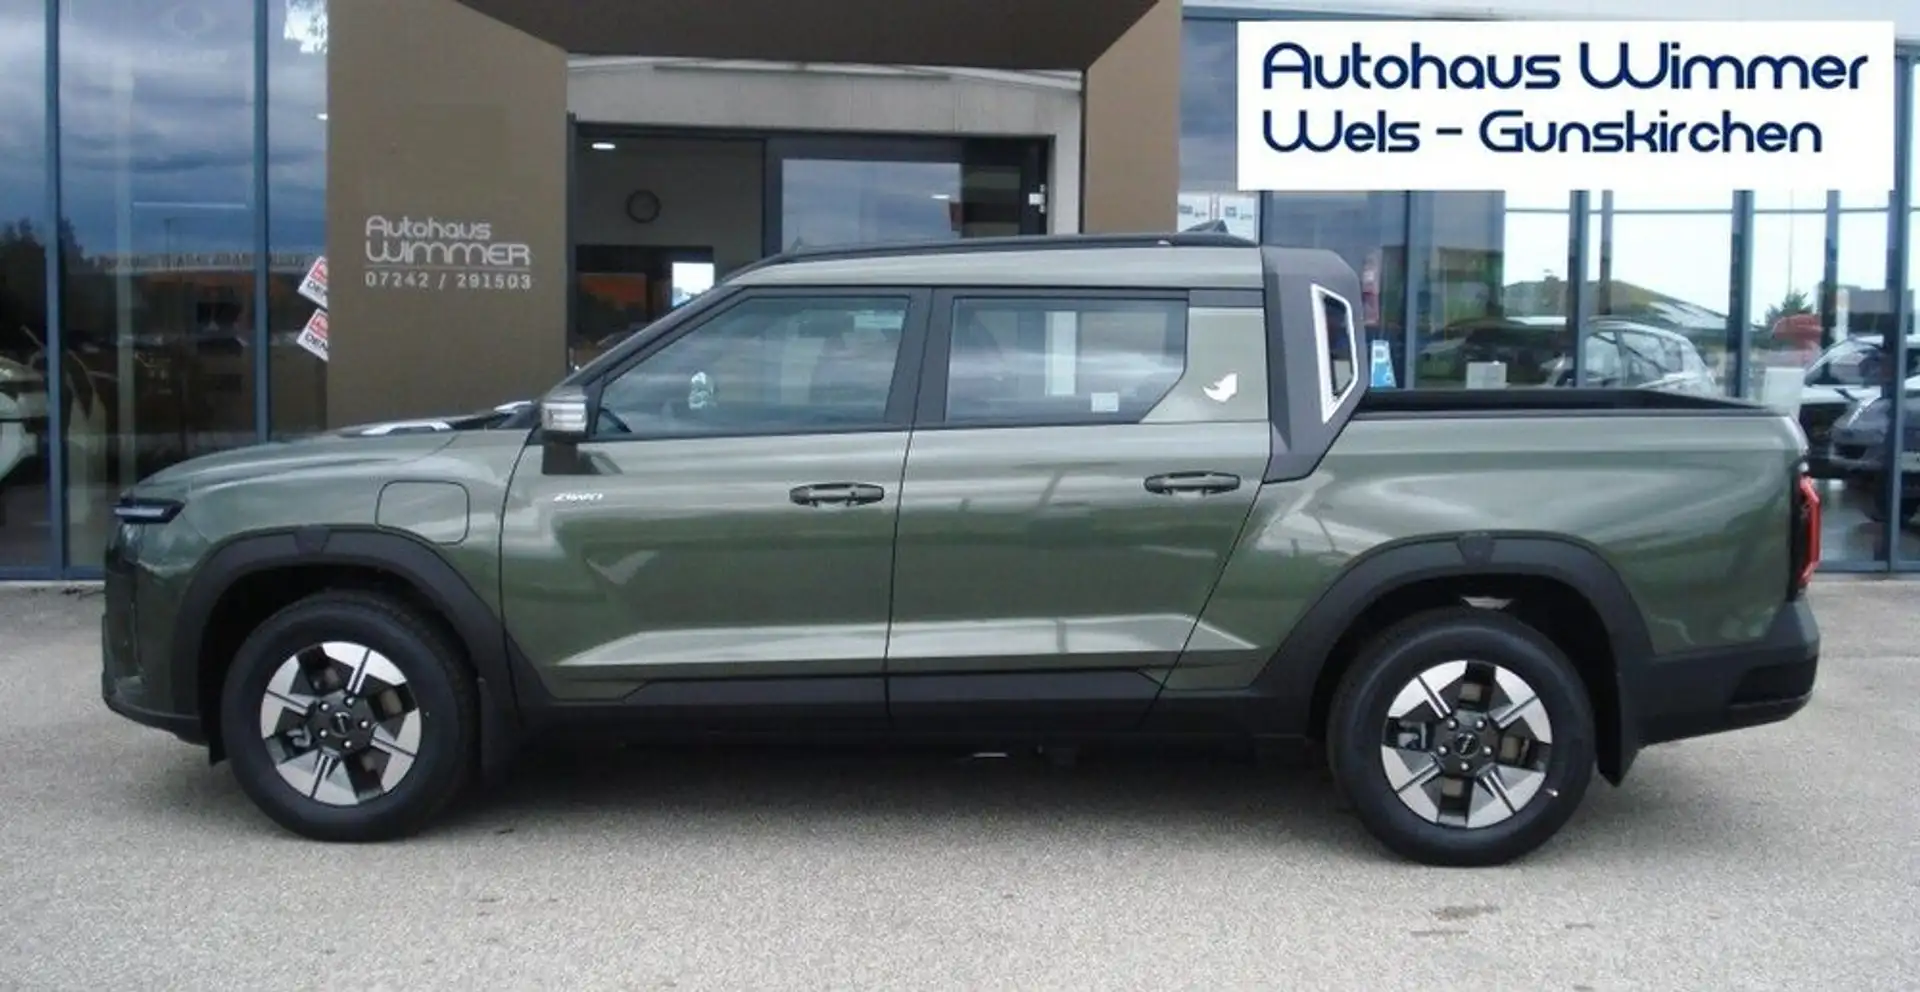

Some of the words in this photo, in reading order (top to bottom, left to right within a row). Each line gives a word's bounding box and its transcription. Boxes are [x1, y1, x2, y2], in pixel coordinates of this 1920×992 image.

[365, 215, 492, 240] Autohaus
[365, 271, 429, 288] 07242
[457, 272, 532, 290] 291503
